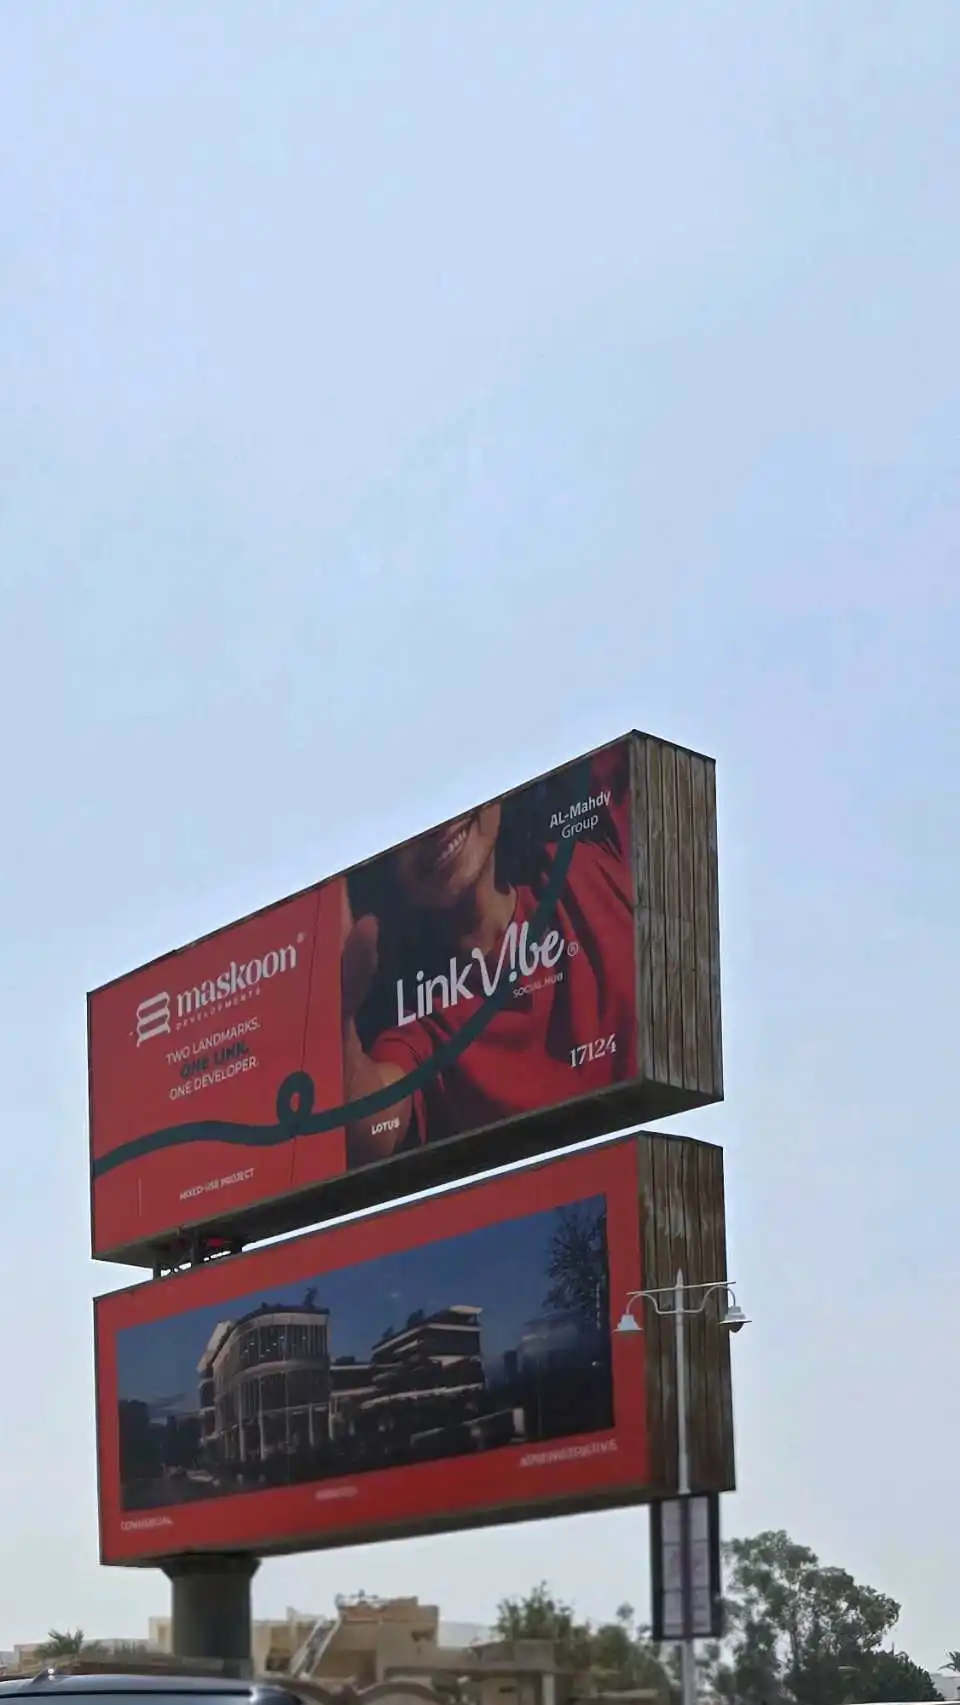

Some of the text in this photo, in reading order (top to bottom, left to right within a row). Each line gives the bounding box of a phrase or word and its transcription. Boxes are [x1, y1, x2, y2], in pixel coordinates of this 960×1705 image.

[550, 790, 611, 829] AL-Mahdy
[561, 815, 599, 839] Group
[177, 944, 297, 1017] maskoon
[166, 1046, 190, 1065] TWO
[570, 1033, 616, 1068] 17124
[169, 1081, 193, 1101] ONE
[371, 1116, 400, 1136] LOTUS
